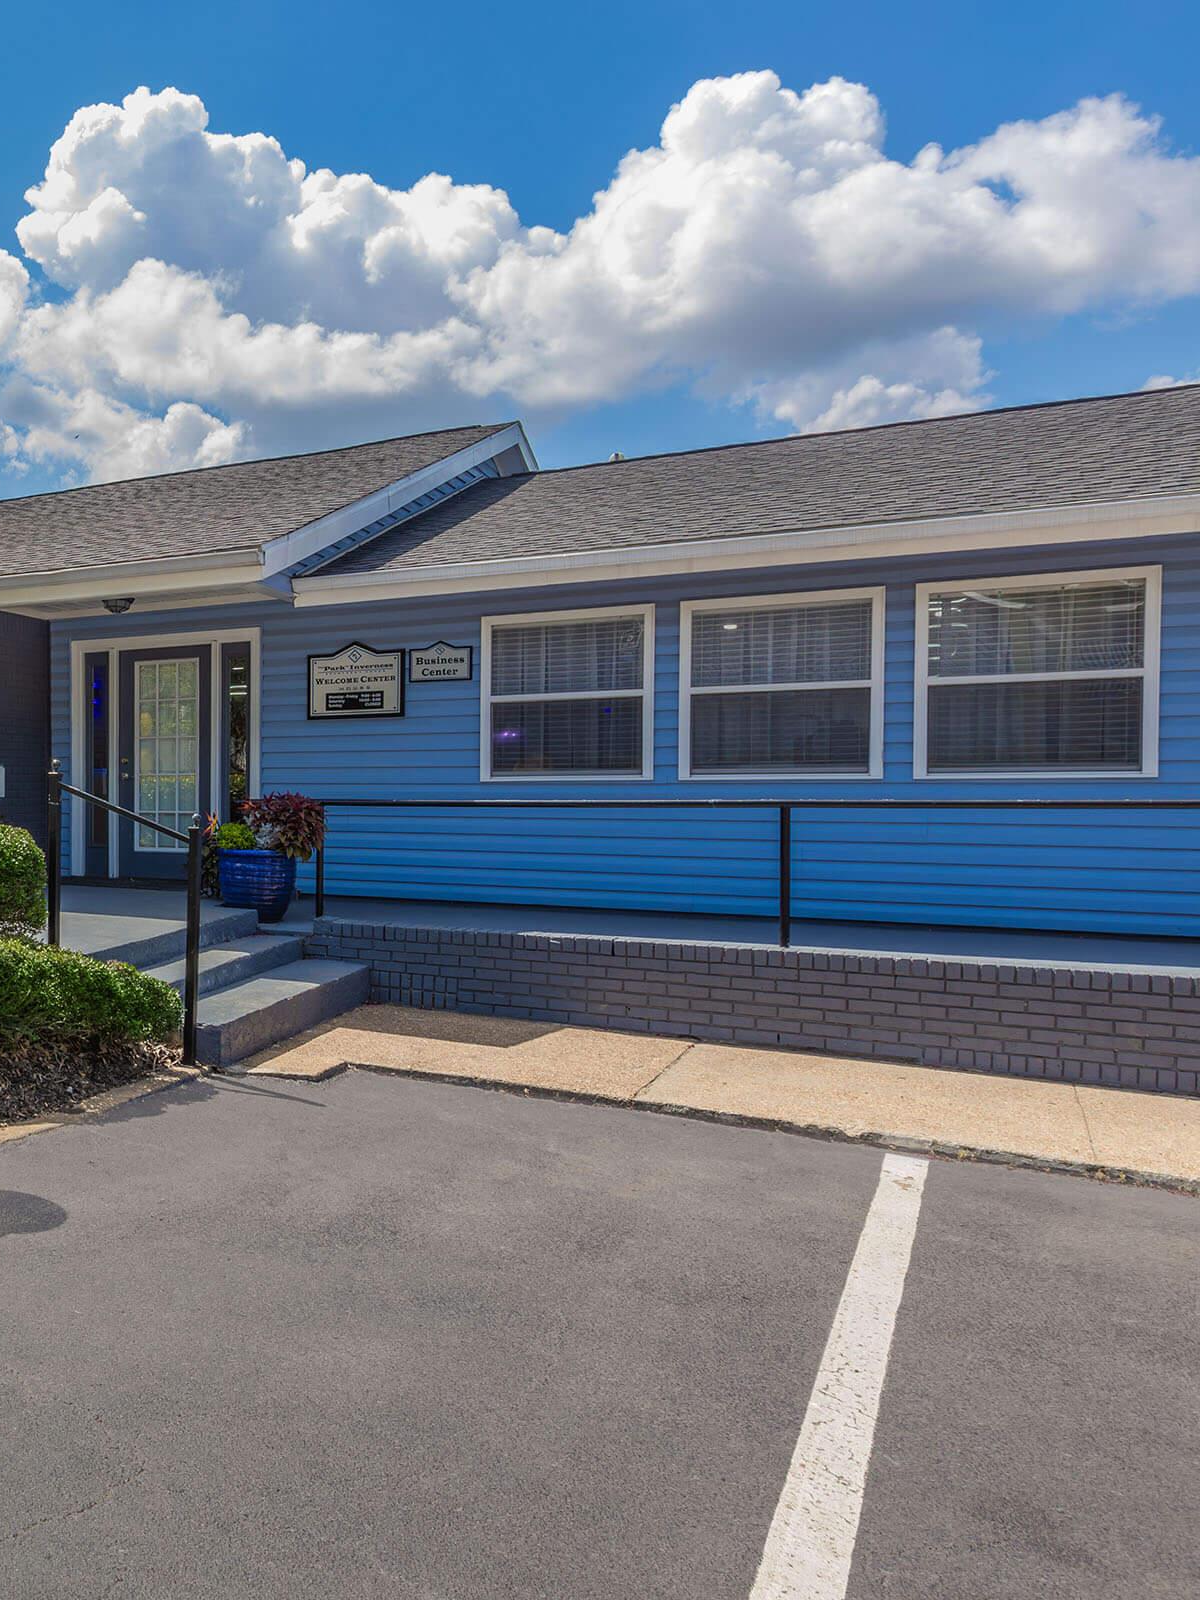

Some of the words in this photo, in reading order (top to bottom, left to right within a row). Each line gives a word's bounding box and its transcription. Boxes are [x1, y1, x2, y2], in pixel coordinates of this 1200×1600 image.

[416, 656, 465, 665] Business
[421, 668, 459, 676] Center
[315, 677, 359, 685] WELCOME
[360, 675, 396, 683] CENTER
